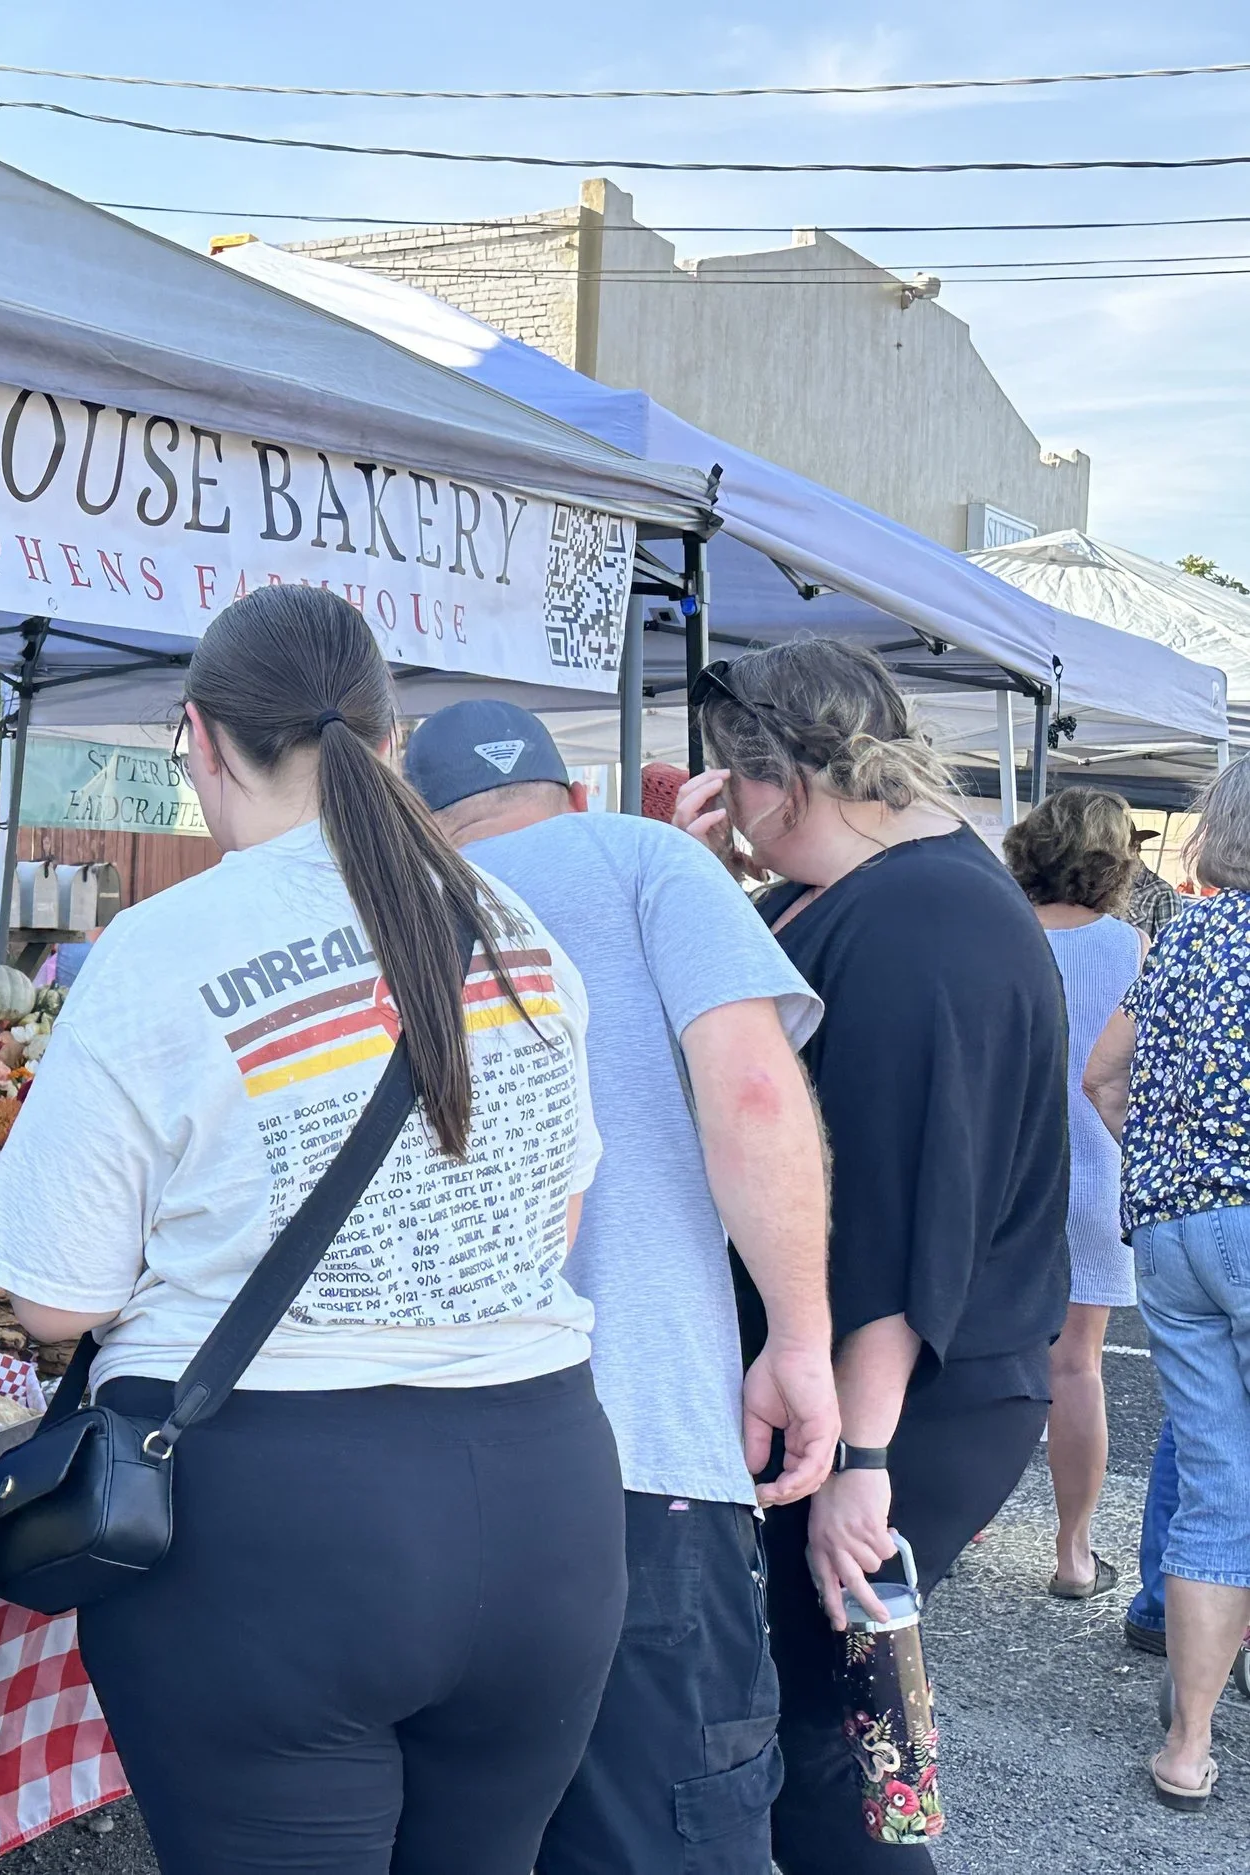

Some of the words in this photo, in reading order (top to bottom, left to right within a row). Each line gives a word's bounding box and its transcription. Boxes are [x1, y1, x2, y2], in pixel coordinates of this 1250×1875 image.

[251, 440, 527, 586] BAKERY
[194, 565, 467, 645] FAHOUSE
[199, 925, 378, 1018] UNREAL
[342, 1092, 358, 1104] CO
[401, 1136, 423, 1149] 6/30
[492, 1147, 504, 1159] NY
[395, 1155, 412, 1167] 7/8
[388, 1188, 403, 1199] CO
[480, 1181, 493, 1193] UT
[398, 1216, 418, 1229] 8/8
[322, 1244, 375, 1262] ORTLAND,
[416, 1228, 440, 1242] 8/14
[370, 1256, 386, 1269] UK
[412, 1243, 440, 1257] 8/29
[411, 1259, 436, 1272] 9/13
[417, 1274, 441, 1287] 9/16
[366, 1299, 381, 1310] PA
[395, 1291, 418, 1304] 9/21
[440, 1300, 454, 1310] CA
[453, 1313, 471, 1324] LAS
